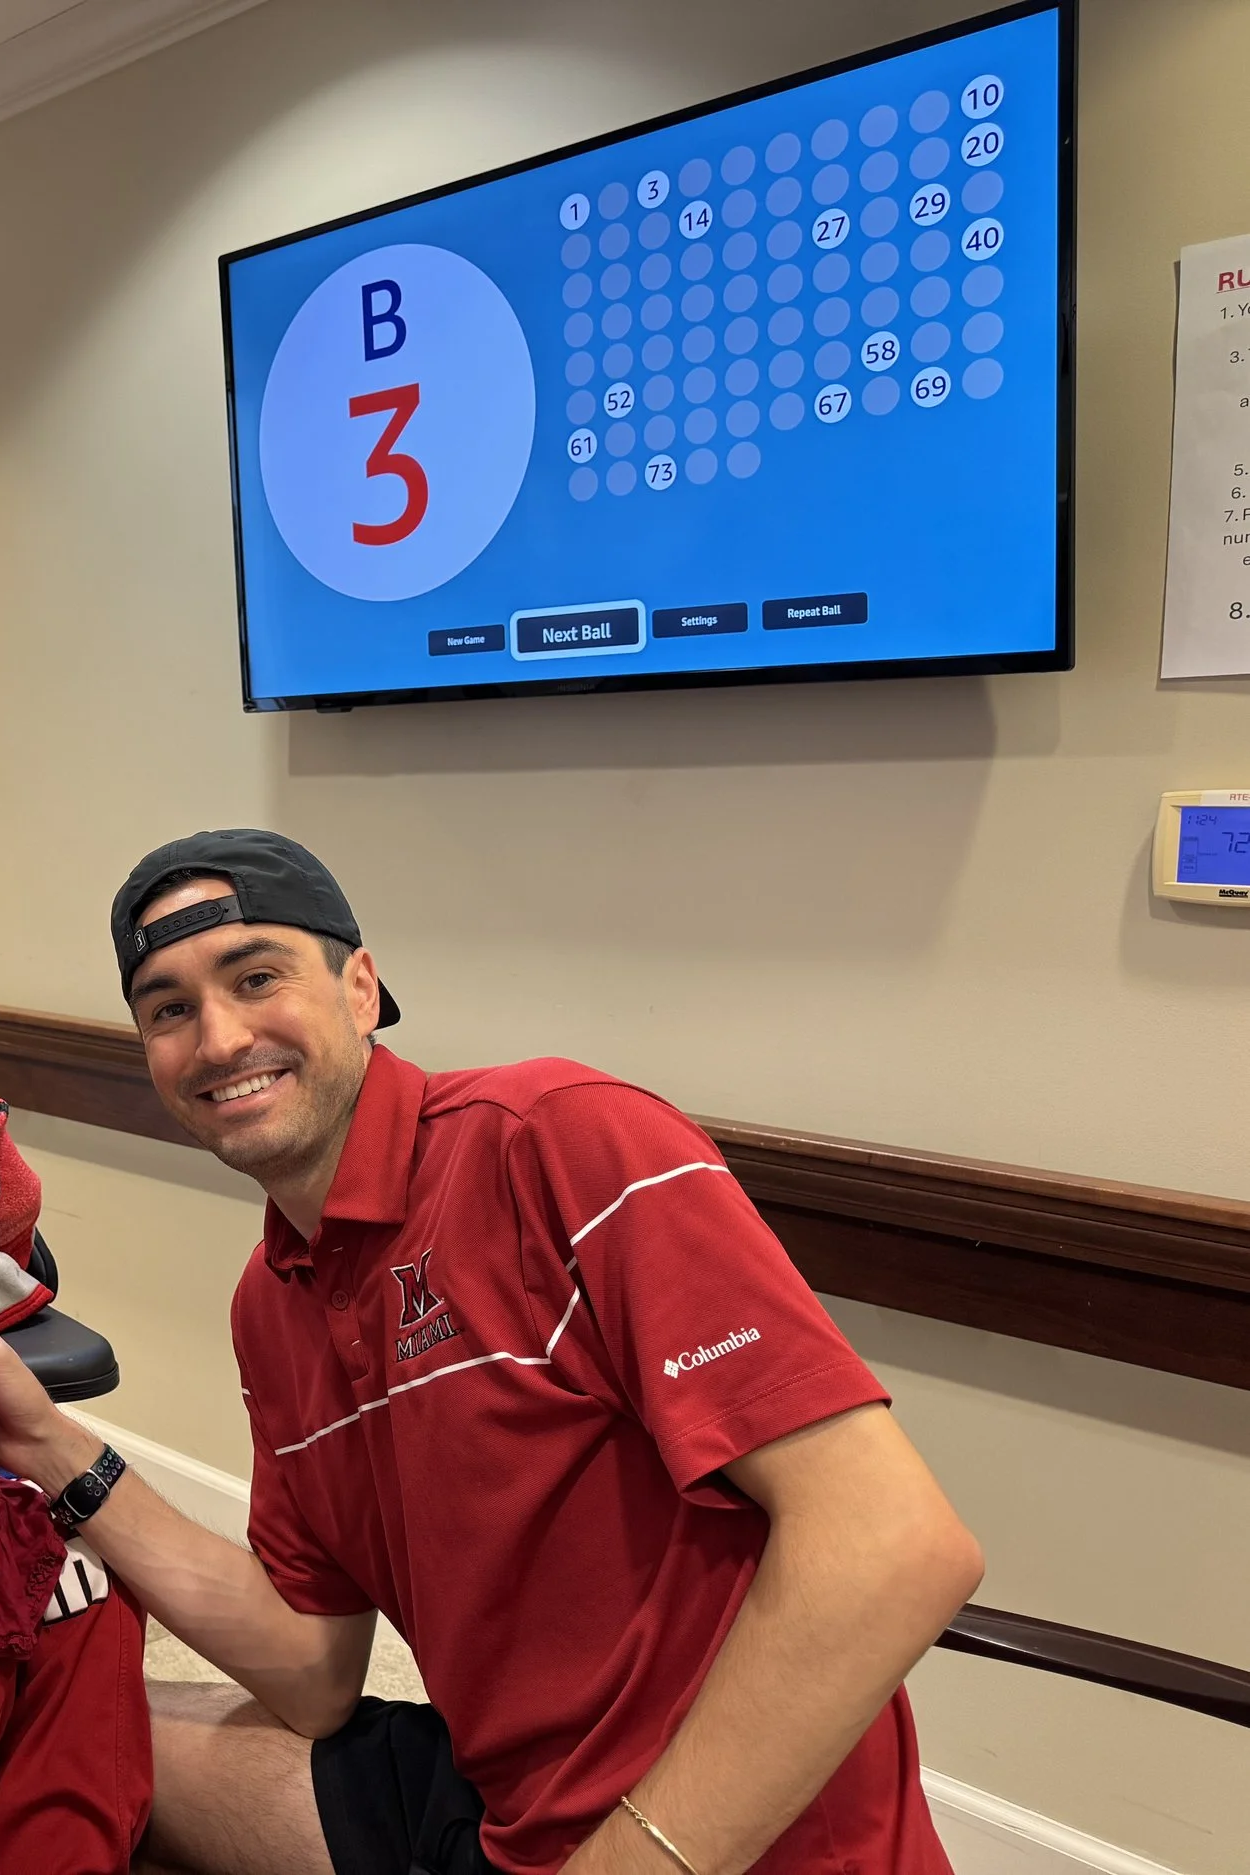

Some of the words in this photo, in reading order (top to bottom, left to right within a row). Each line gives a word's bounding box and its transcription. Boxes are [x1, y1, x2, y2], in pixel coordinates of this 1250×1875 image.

[968, 84, 998, 110] 10
[967, 132, 998, 158] 20
[570, 203, 577, 220] 1
[648, 180, 658, 200] 3
[684, 209, 710, 232] 14
[817, 217, 844, 241] 27
[915, 193, 945, 220] 29
[967, 227, 998, 251] 40
[361, 278, 408, 362] B
[1220, 306, 1234, 320] 1.
[867, 340, 895, 364] 58
[1230, 351, 1245, 364] 3.
[608, 391, 633, 411] 52
[819, 393, 846, 415] 67
[916, 376, 946, 399] 69
[571, 437, 591, 456] 61
[348, 382, 430, 546] 3
[648, 463, 672, 483] 73
[1234, 464, 1248, 476] 5.
[1231, 486, 1246, 500] 6.
[1223, 510, 1238, 523] 7.
[681, 614, 718, 628] Settings
[787, 606, 820, 620] Repeat
[822, 604, 842, 616] Ball
[1230, 602, 1250, 620] 8.
[448, 637, 462, 646] New
[464, 634, 486, 646] Game
[542, 626, 578, 643] Next
[582, 622, 612, 640] Ball
[1222, 832, 1250, 854] 72
[396, 1312, 455, 1362] MIAMI
[678, 1328, 761, 1370] Columbia
